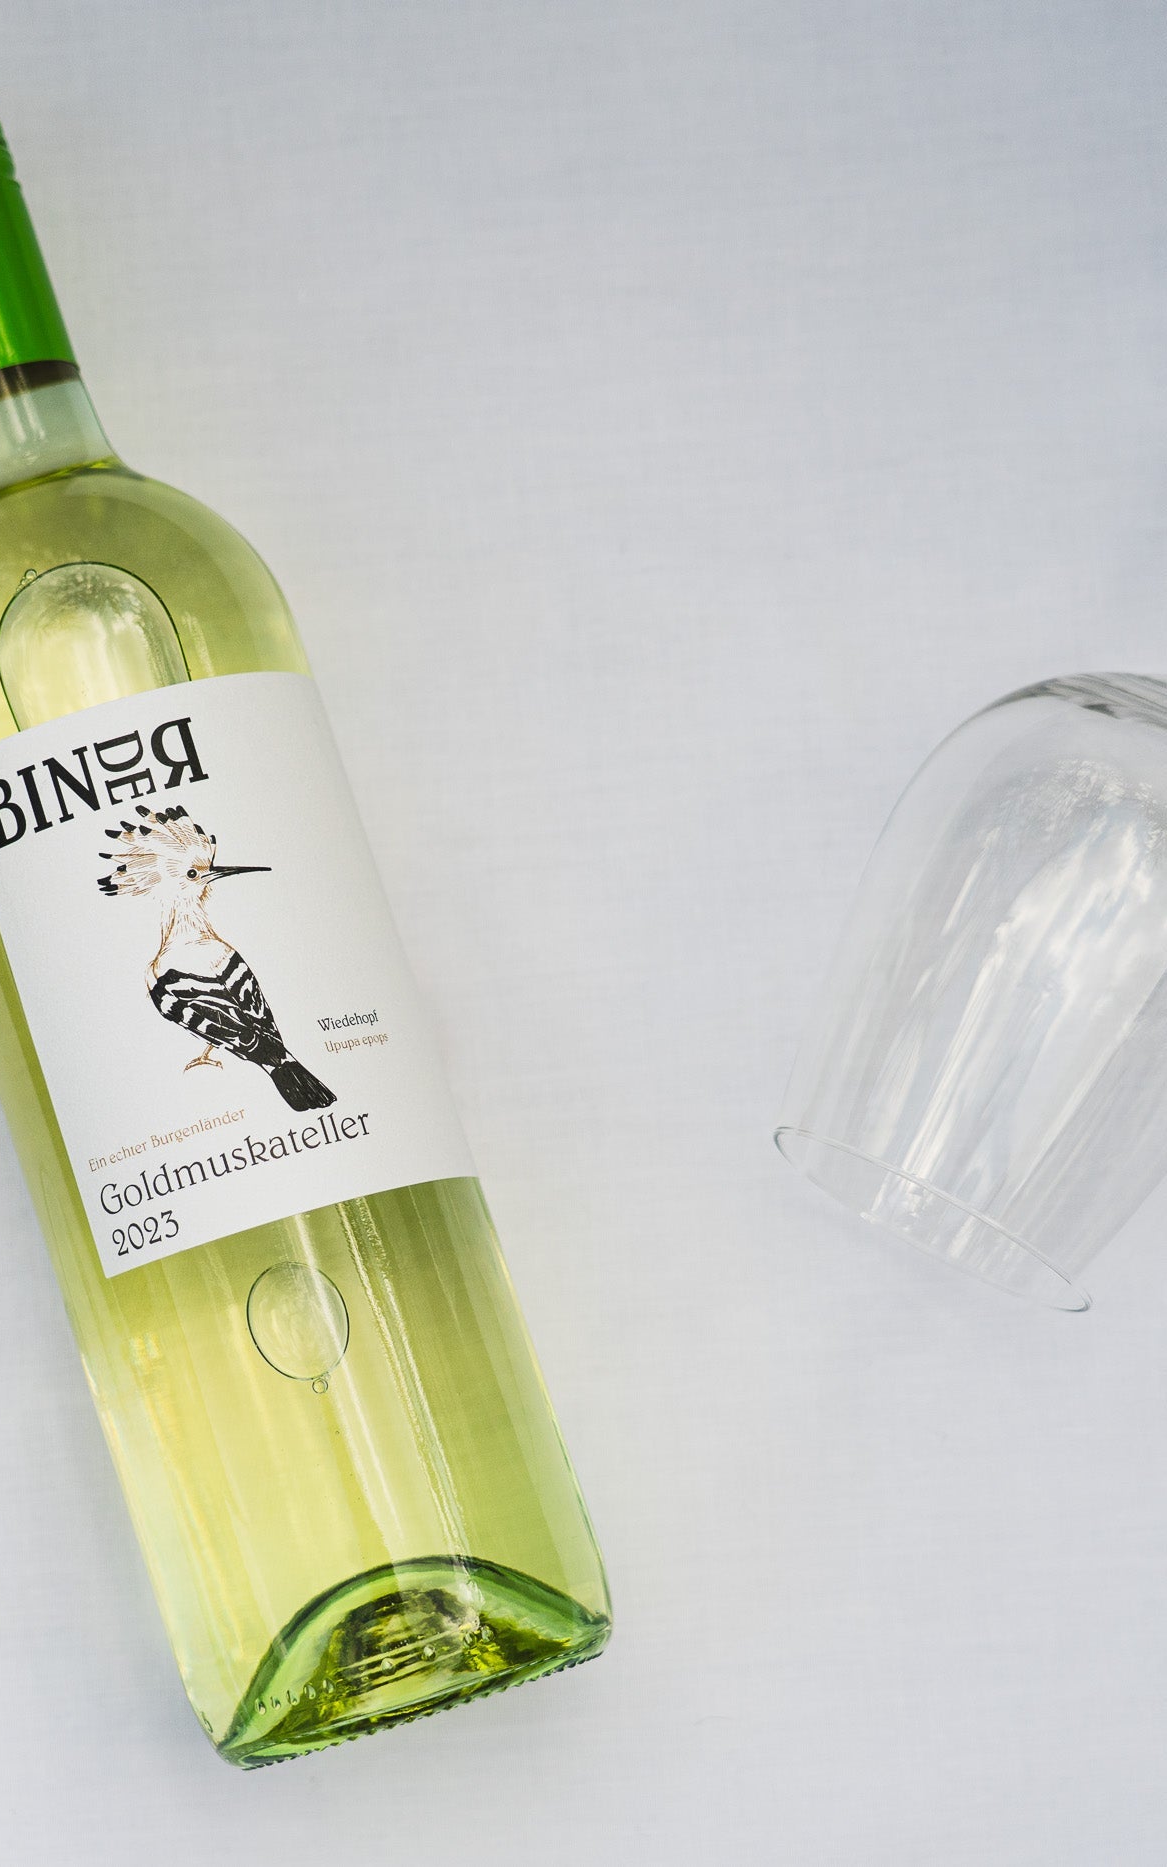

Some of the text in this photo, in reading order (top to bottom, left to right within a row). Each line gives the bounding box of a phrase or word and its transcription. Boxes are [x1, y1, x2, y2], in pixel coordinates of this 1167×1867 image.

[317, 1009, 379, 1032] Wiedehopf
[324, 1033, 389, 1053] Upupa epops
[88, 1108, 245, 1172] Ein echter Burgenländer
[100, 1112, 370, 1215] Goldmuskateller
[112, 1209, 180, 1257] 2023
